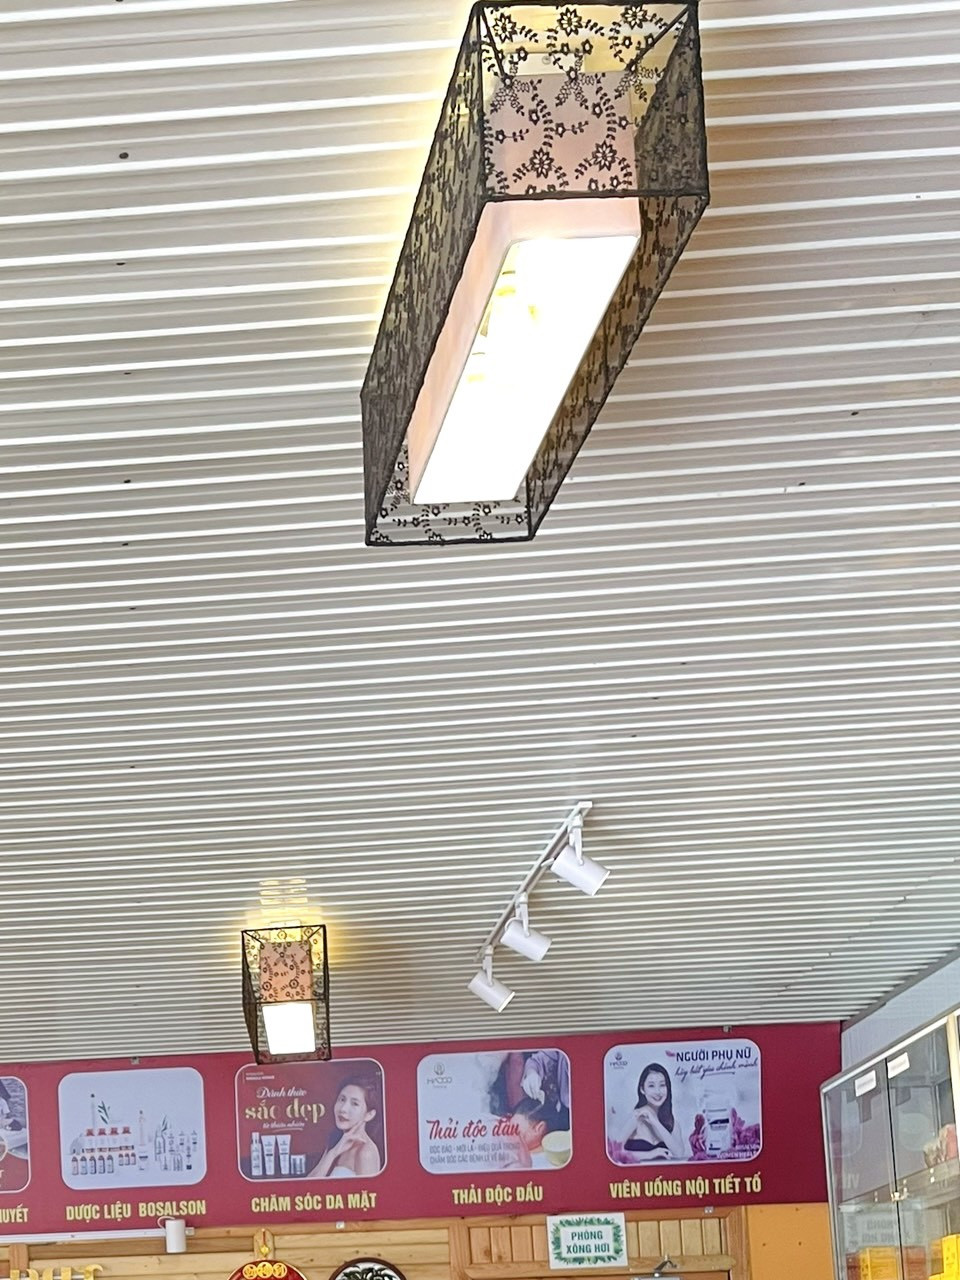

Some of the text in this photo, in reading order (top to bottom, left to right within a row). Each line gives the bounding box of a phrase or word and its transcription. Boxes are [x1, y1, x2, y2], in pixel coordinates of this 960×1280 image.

[245, 1099, 277, 1120] sắc
[452, 1184, 482, 1205] THẢI
[485, 1184, 512, 1206] ĐỘC
[609, 1172, 762, 1198] VIÊN UỐNG NỘI TIẾT TỐ
[66, 1200, 207, 1223] DƯỢC LIỆU BOSALSON
[251, 1190, 377, 1212] CHĂM SÓC DA MẶT
[571, 1229, 603, 1240] PHÒNG
[566, 1243, 610, 1254] XÔNG HƠI
